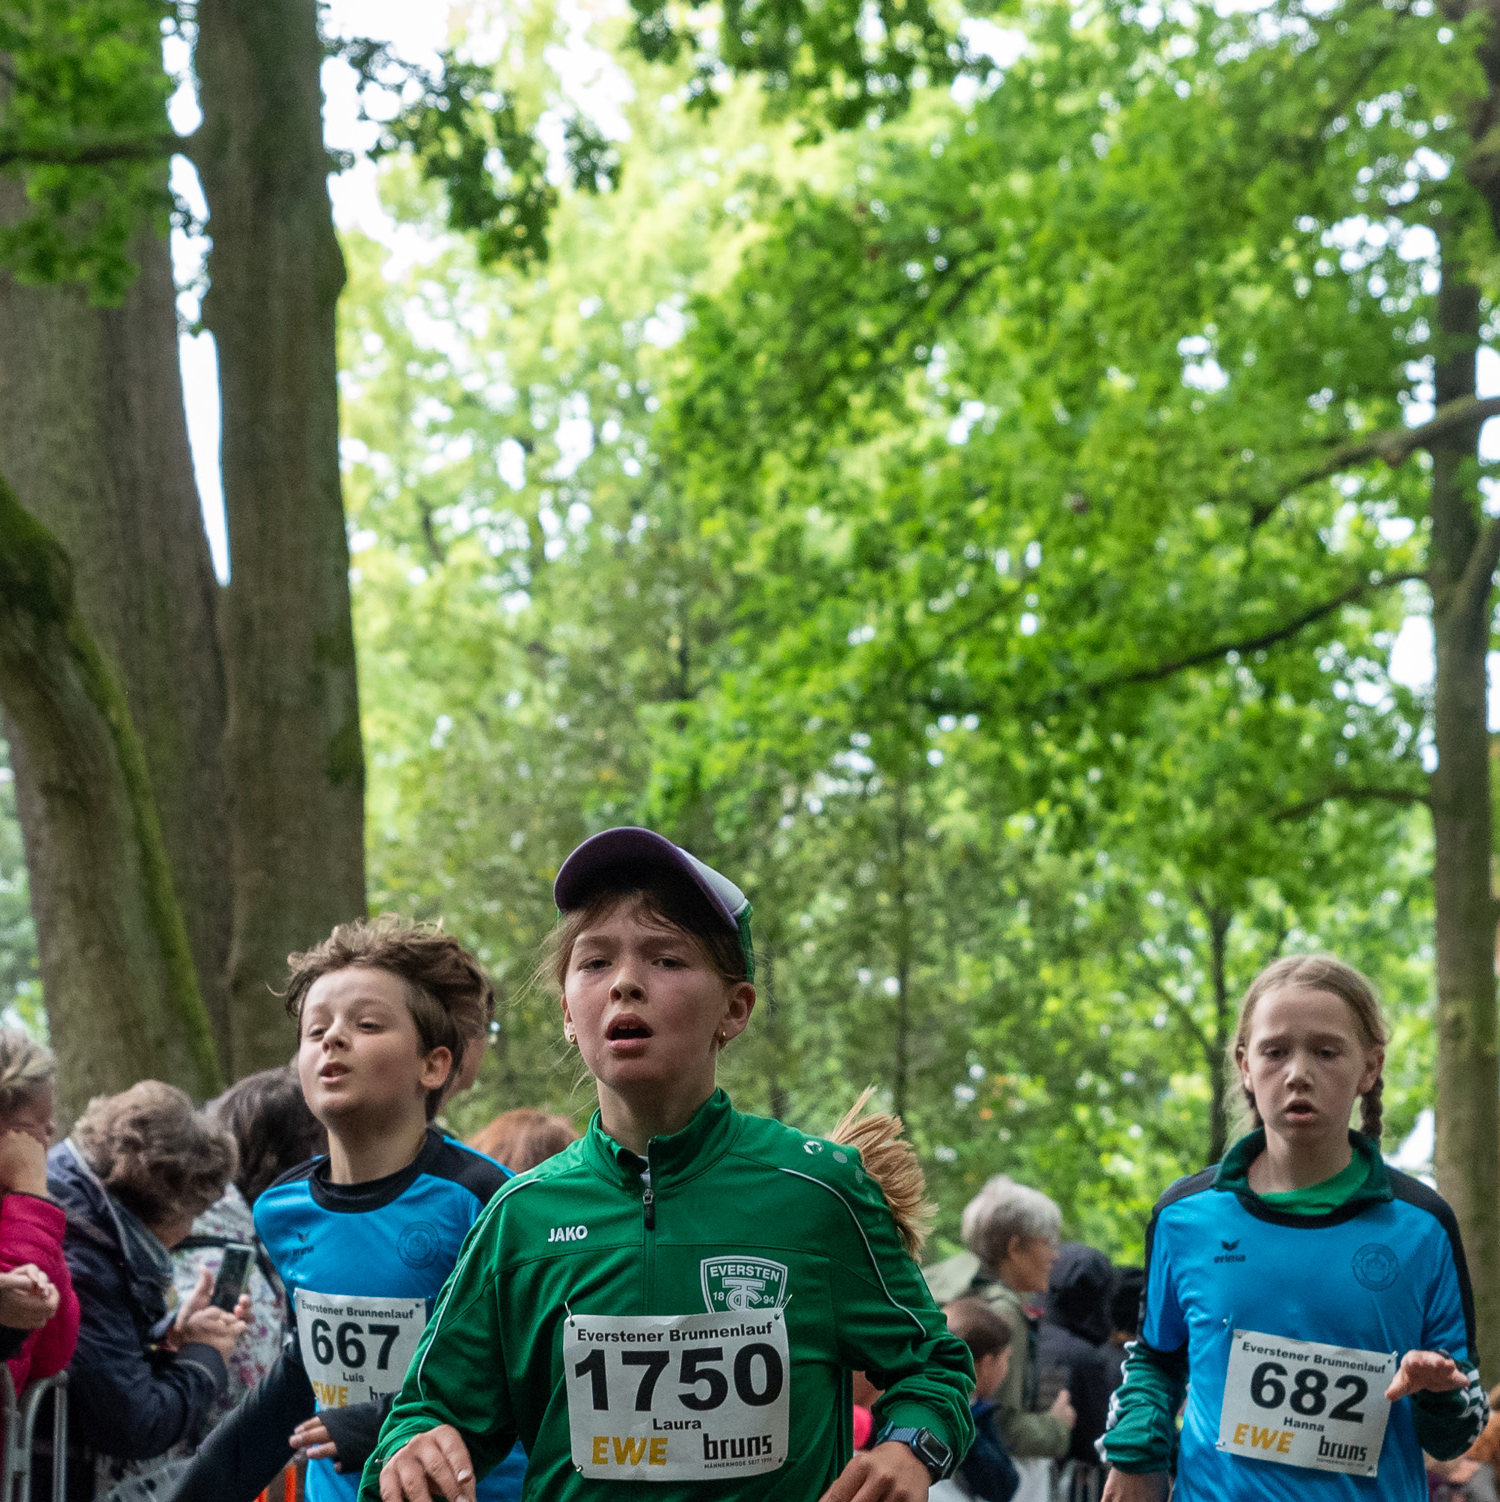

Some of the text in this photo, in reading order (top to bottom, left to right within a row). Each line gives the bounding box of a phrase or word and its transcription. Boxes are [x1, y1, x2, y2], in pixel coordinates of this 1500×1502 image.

[547, 1225, 588, 1243] JAKO
[709, 1264, 780, 1283] EVERSTEN
[712, 1291, 775, 1305] 18 94
[302, 1300, 414, 1319] Everstener Brunnenlauf
[577, 1322, 773, 1343] Everstener Brunnenlauf
[311, 1318, 400, 1371] 667
[1242, 1341, 1386, 1374] Everstener Brunnenlauf
[342, 1372, 365, 1383] Luis
[574, 1342, 784, 1412] 1750
[312, 1380, 349, 1408] EWE
[1250, 1361, 1369, 1425] 682
[652, 1418, 702, 1431] Laura
[1283, 1416, 1325, 1433] Hanna
[592, 1433, 772, 1466] EWE bruns
[1232, 1422, 1368, 1463] EWE bruns
